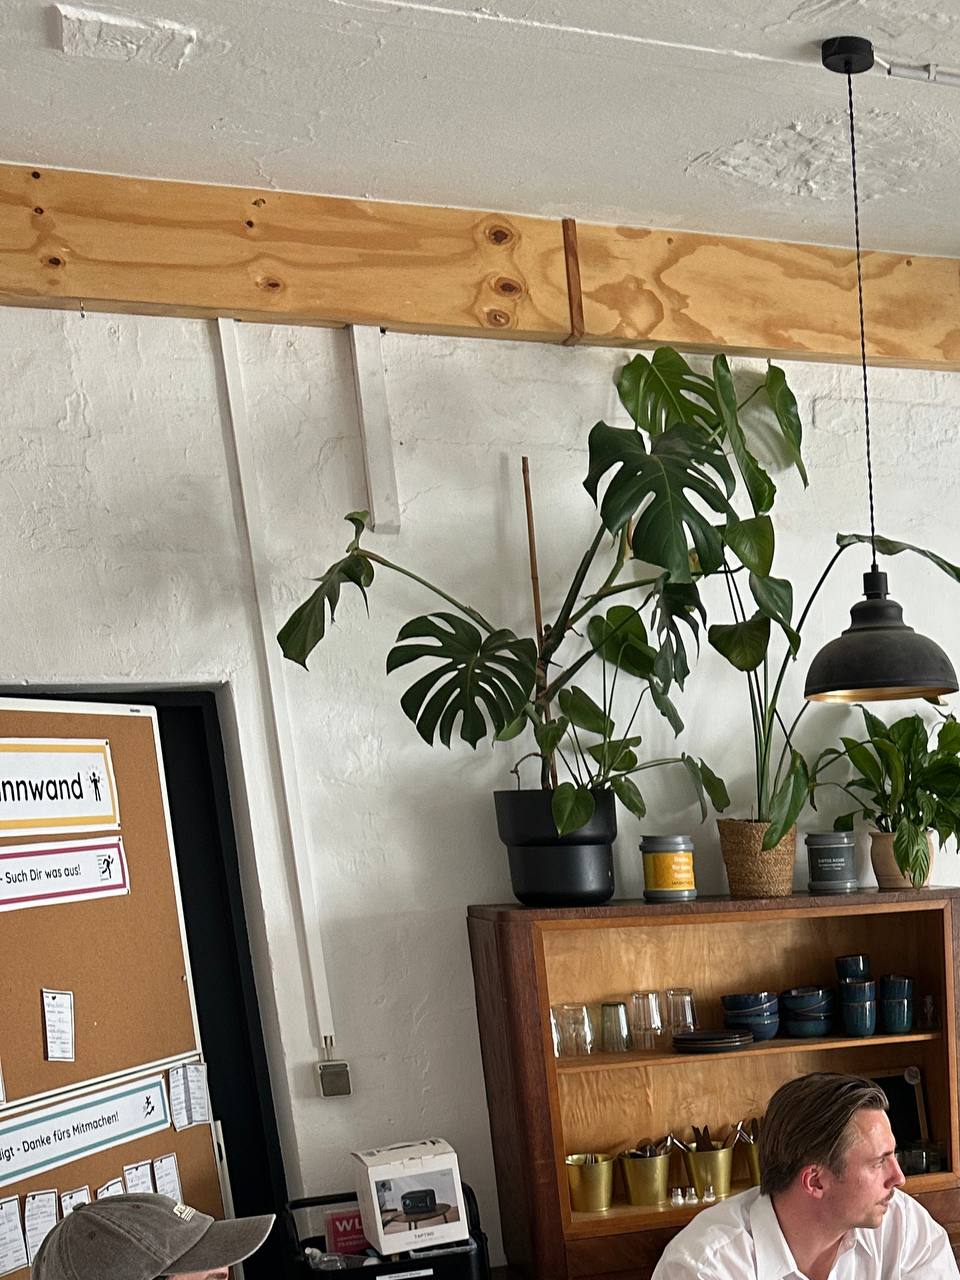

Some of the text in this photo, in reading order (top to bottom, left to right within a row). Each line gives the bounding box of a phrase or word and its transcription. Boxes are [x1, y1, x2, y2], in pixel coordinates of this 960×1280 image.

[0, 772, 84, 802] nnwand
[5, 870, 28, 884] Such
[29, 867, 42, 881] Dir
[44, 867, 62, 879] was
[64, 864, 81, 876] aus!
[22, 1135, 51, 1153] Danke
[53, 1127, 71, 1143] fürs
[72, 1111, 119, 1136] Mitmachen!
